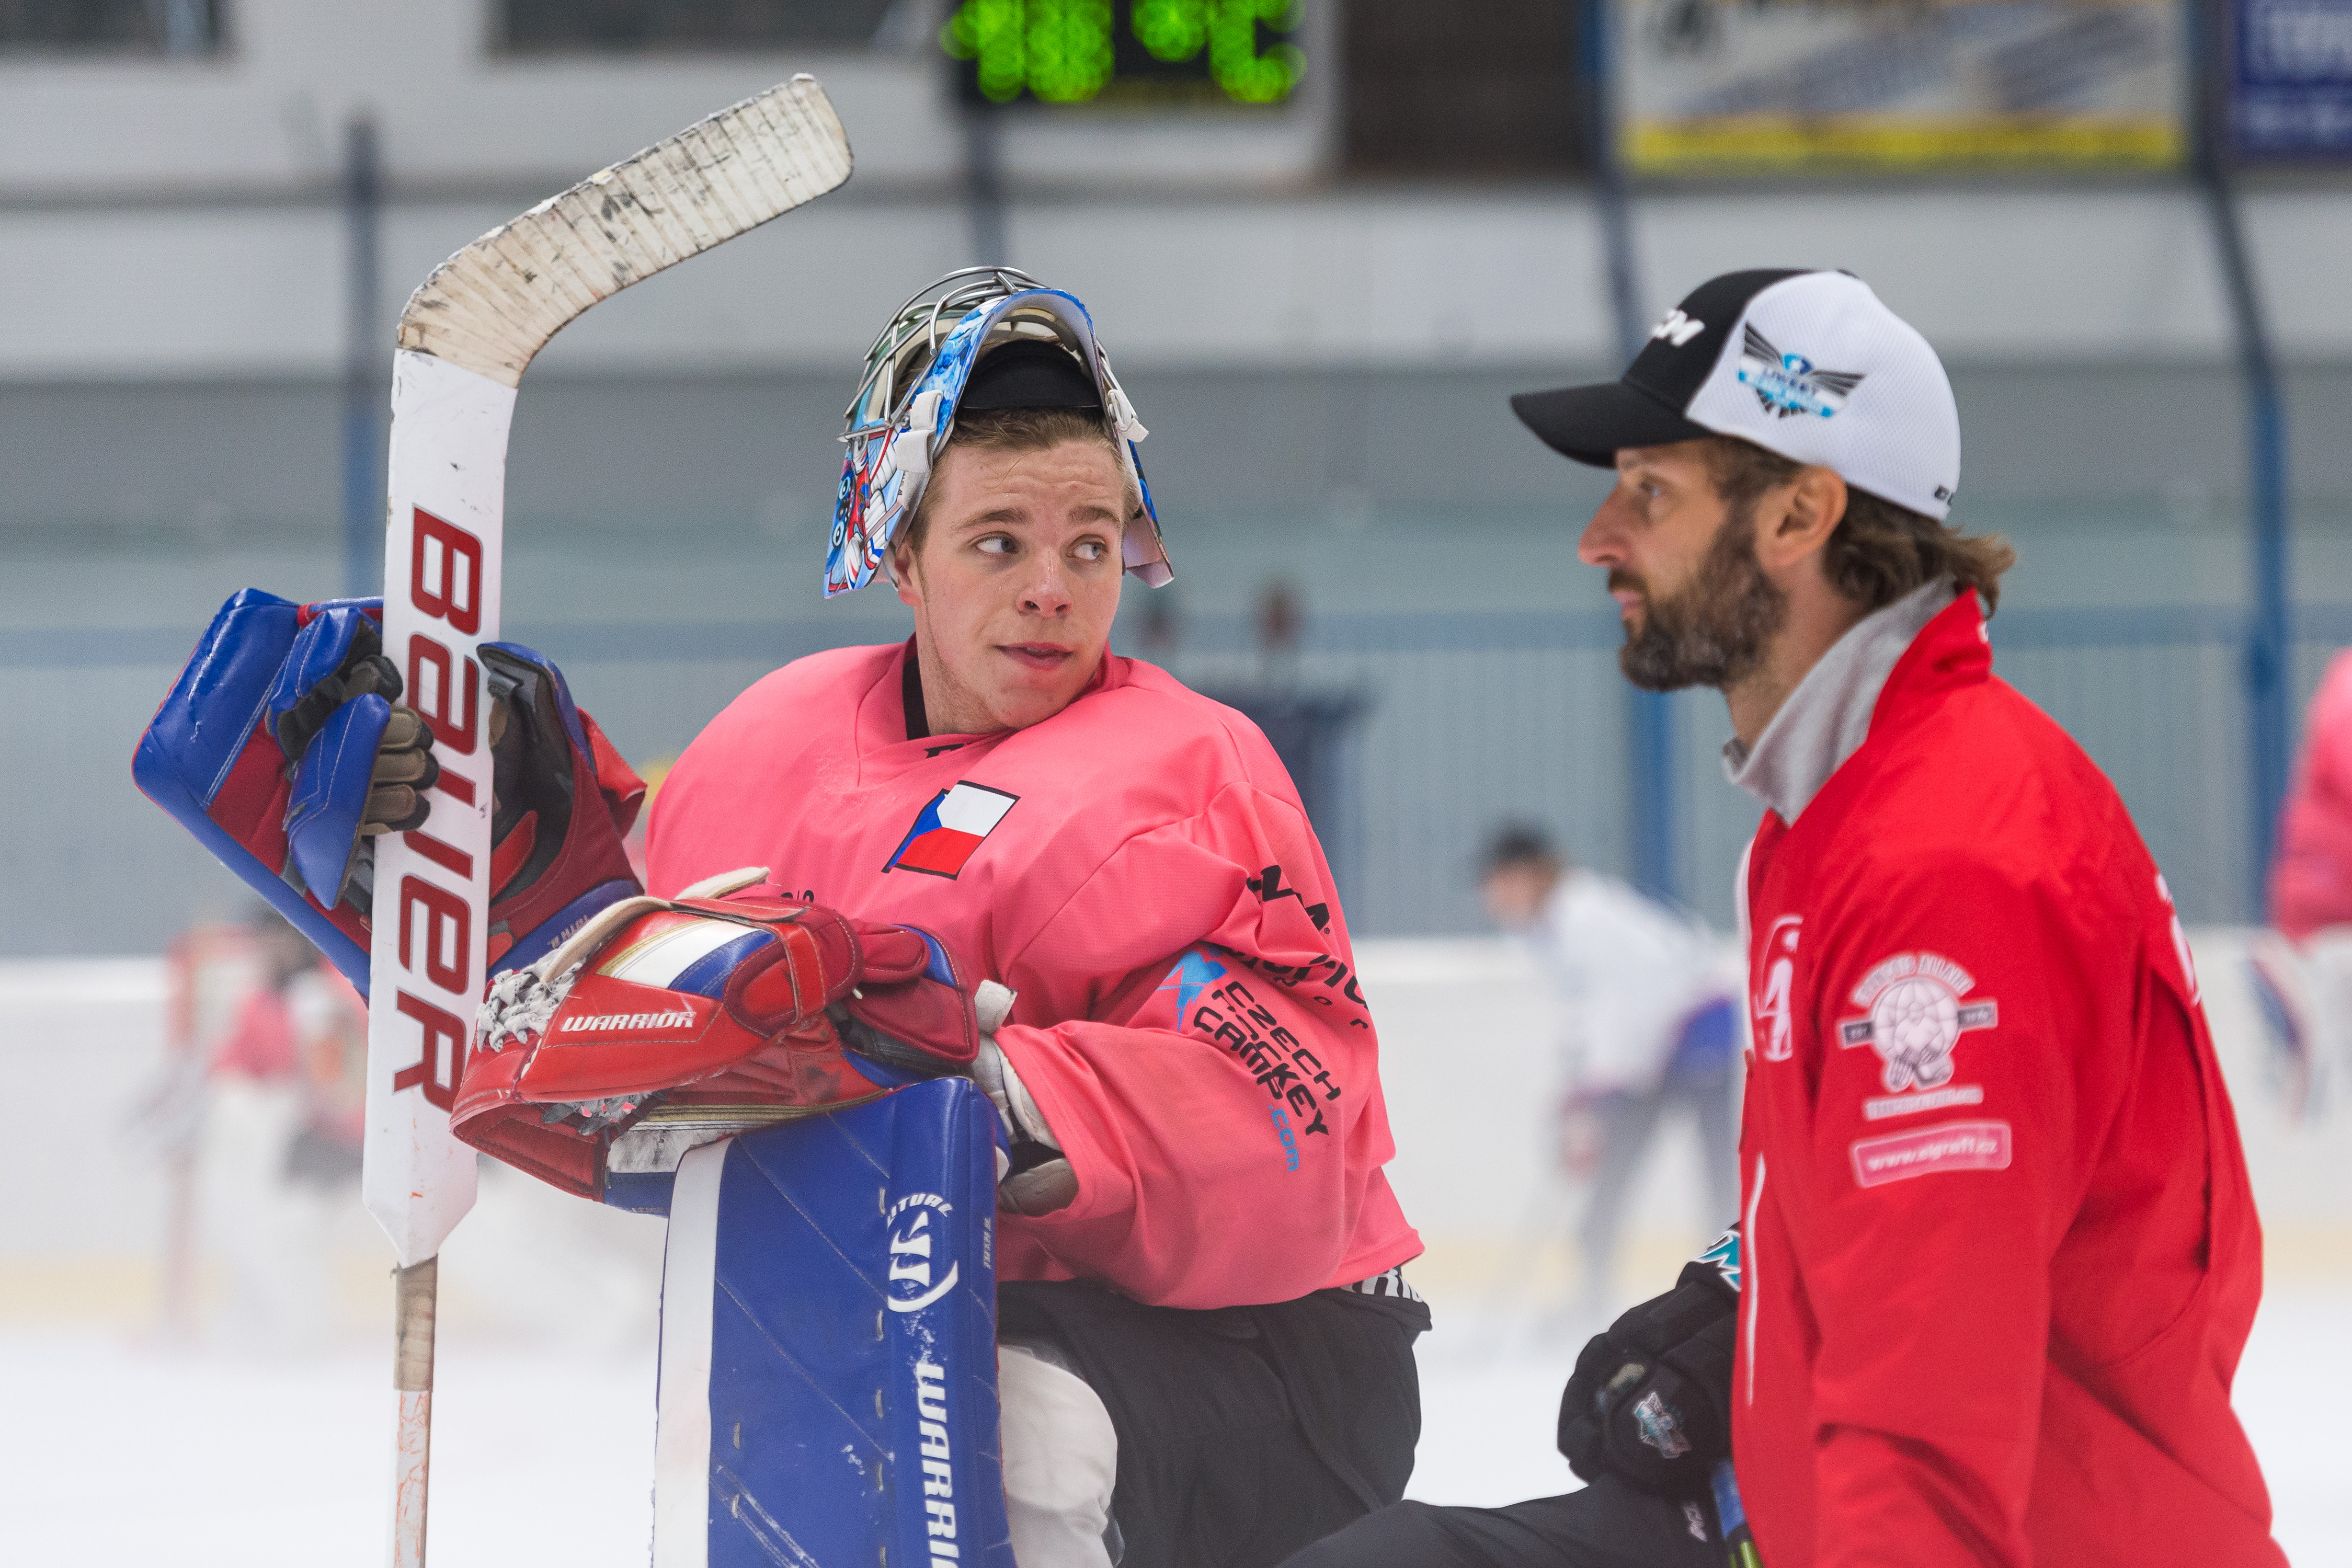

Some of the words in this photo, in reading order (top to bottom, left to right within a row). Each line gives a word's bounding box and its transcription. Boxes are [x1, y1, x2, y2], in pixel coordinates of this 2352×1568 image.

[559, 1011, 697, 1033] WARRIOR
[1225, 981, 1342, 1101] CZECH
[916, 1363, 961, 1568] WARRI
